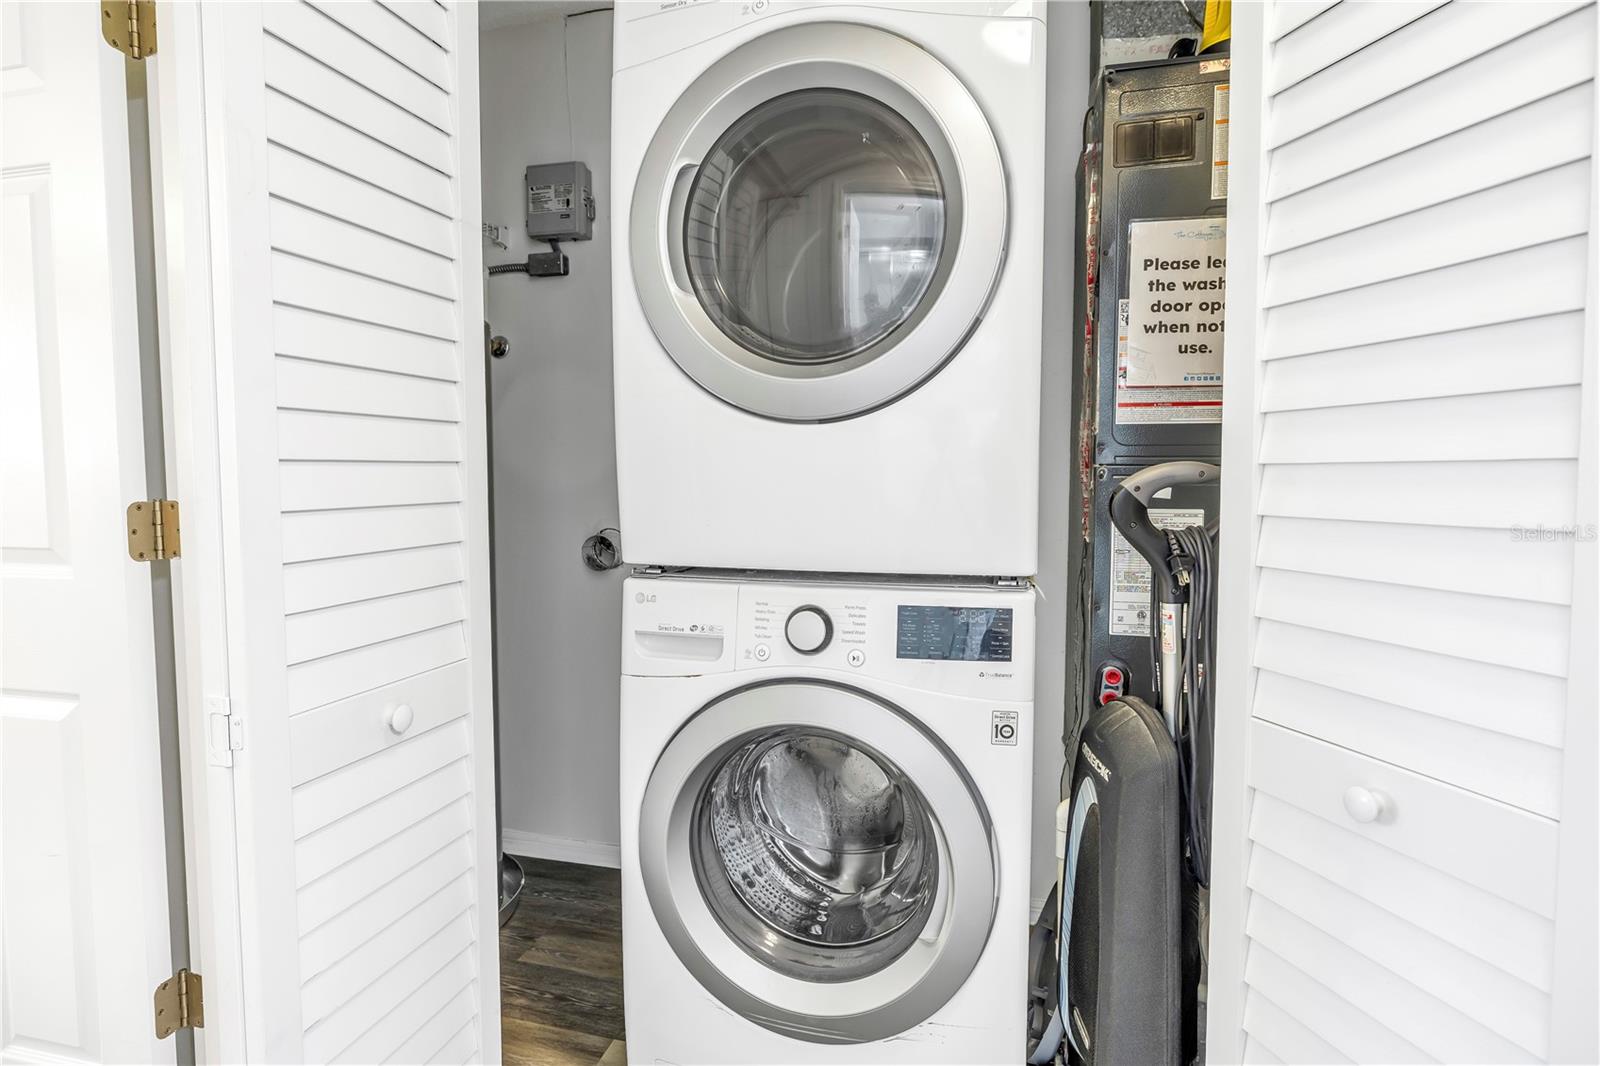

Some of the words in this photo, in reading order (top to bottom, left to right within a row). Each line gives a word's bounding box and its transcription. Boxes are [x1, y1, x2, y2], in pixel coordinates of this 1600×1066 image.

[1143, 257, 1201, 271] Please
[1207, 255, 1226, 269] le
[1148, 279, 1176, 292] the
[1182, 276, 1226, 291] wash
[1150, 300, 1193, 313] door
[1198, 301, 1225, 315] op
[1143, 321, 1190, 334] when
[1196, 320, 1225, 333] not
[1178, 343, 1213, 354] use.
[658, 624, 672, 632] Direct
[994, 723, 1014, 739] 10
